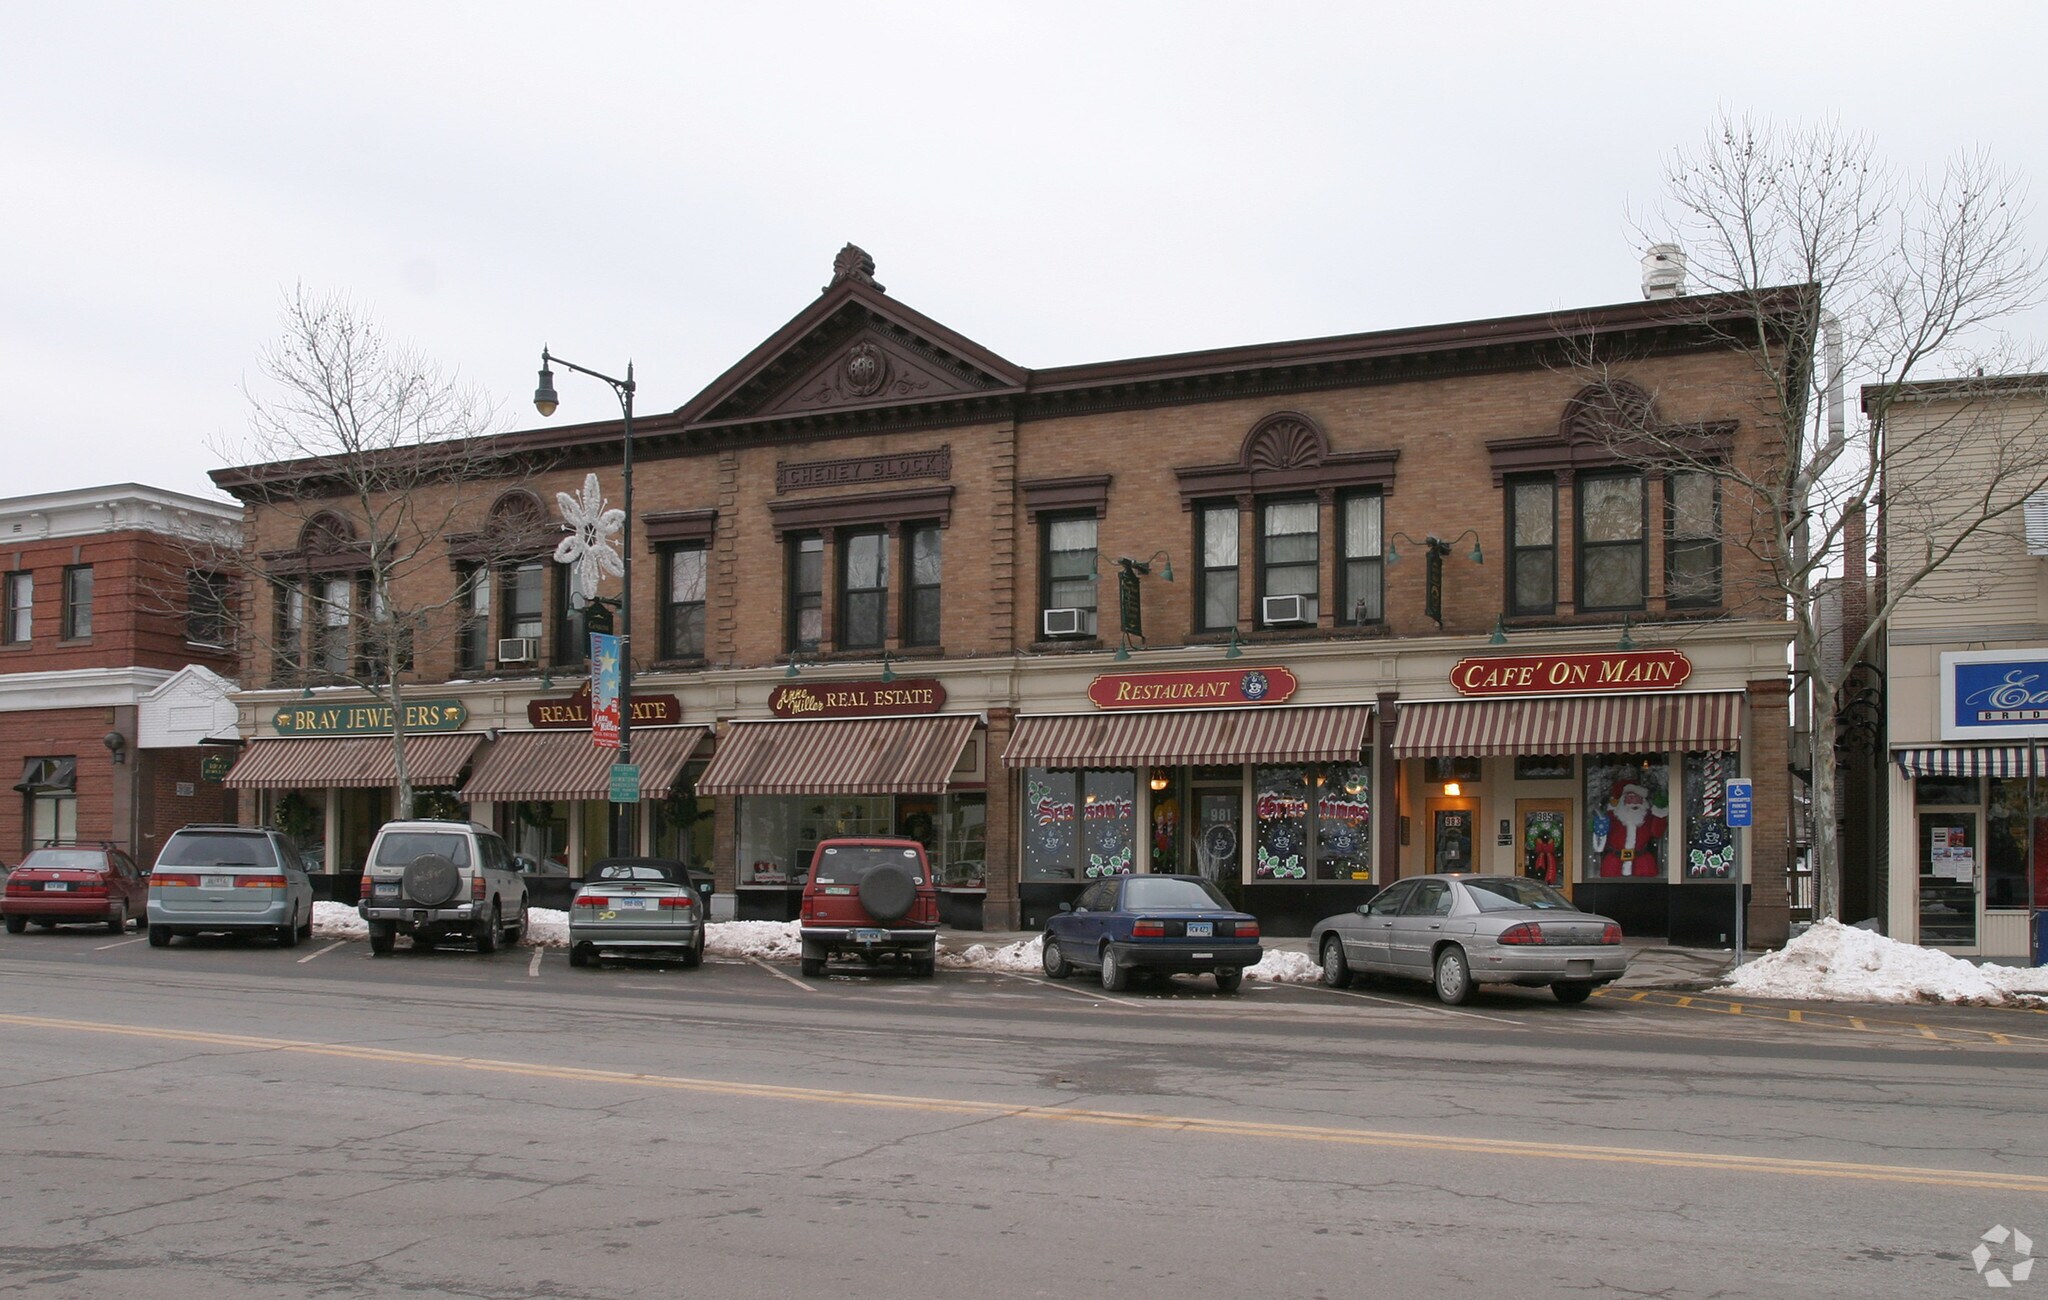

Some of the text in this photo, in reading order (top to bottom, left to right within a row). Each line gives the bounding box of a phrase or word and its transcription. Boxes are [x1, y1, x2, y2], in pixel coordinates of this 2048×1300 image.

[790, 455, 936, 484] CHENEY BLOCK
[776, 688, 808, 710] Anne
[826, 689, 934, 707] REAL ESTATE
[1116, 681, 1230, 701] RESTAURANT
[539, 706, 589, 722] REAL
[788, 695, 824, 715] Miller
[295, 706, 440, 730] BRAY JEWEERS
[1210, 808, 1231, 822] 981
[1445, 816, 1461, 827] 983
[1537, 812, 1553, 821] 985
